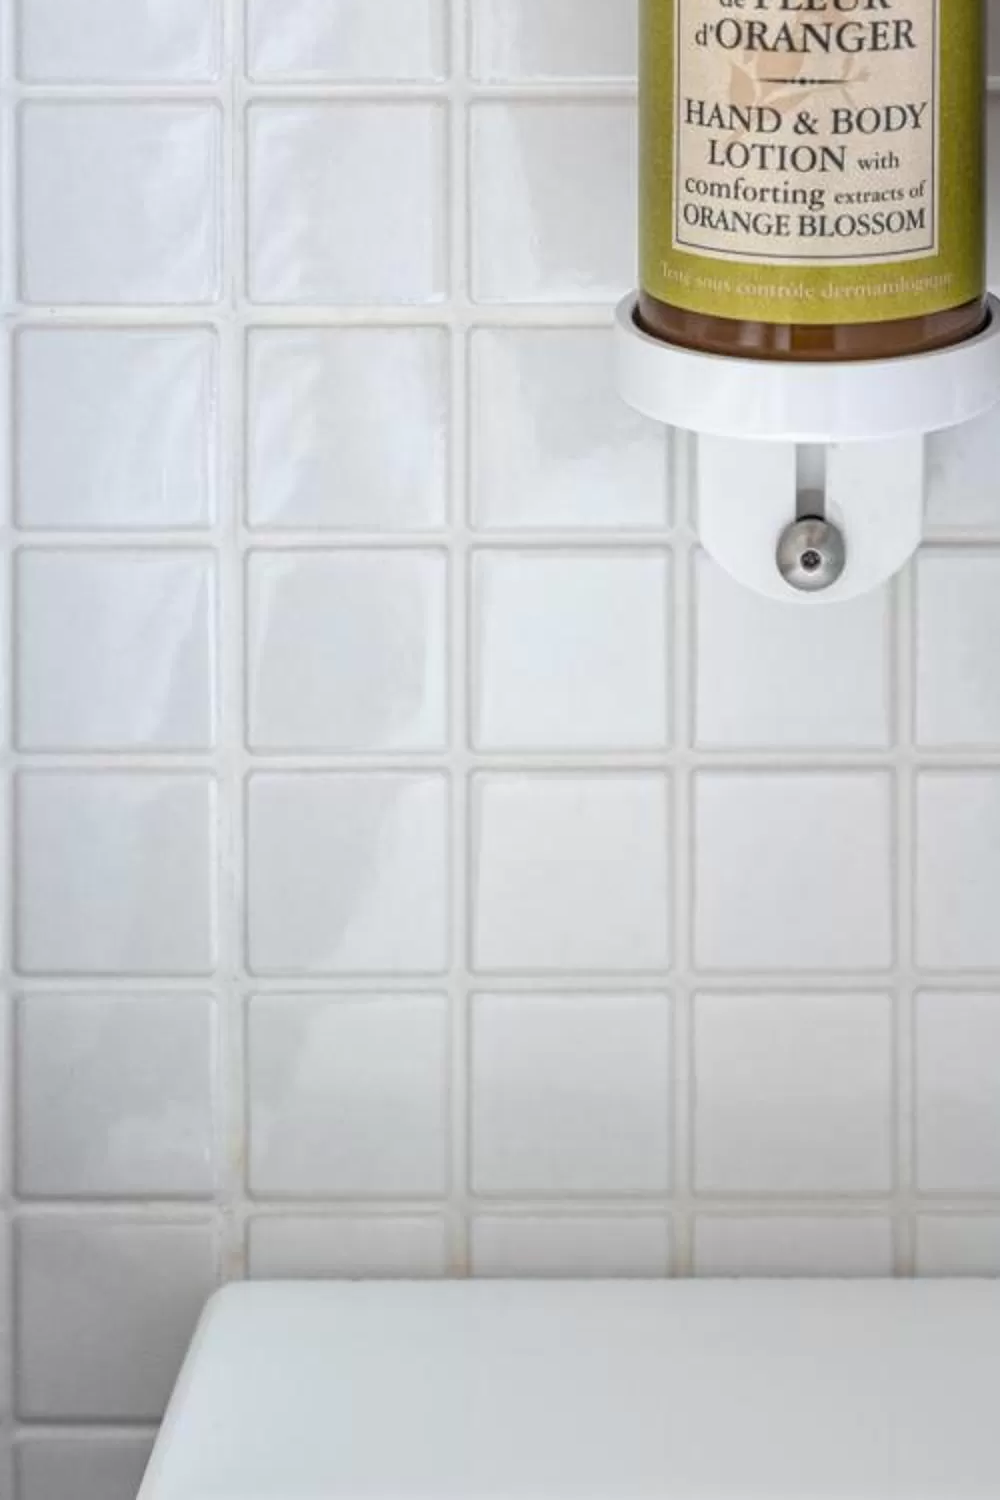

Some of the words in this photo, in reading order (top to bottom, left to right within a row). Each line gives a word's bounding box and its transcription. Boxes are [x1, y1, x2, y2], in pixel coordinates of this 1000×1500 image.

[695, 18, 917, 53] d'ORANGER
[684, 98, 781, 133] HAND
[793, 111, 818, 135] &
[831, 102, 928, 135] BODY
[707, 139, 847, 173] LOTION
[857, 152, 900, 171] with
[685, 177, 825, 211] comforting
[834, 187, 904, 205] extracts
[909, 180, 927, 198] of
[683, 203, 790, 237] ORANGE
[799, 208, 926, 237] BLOSSOM
